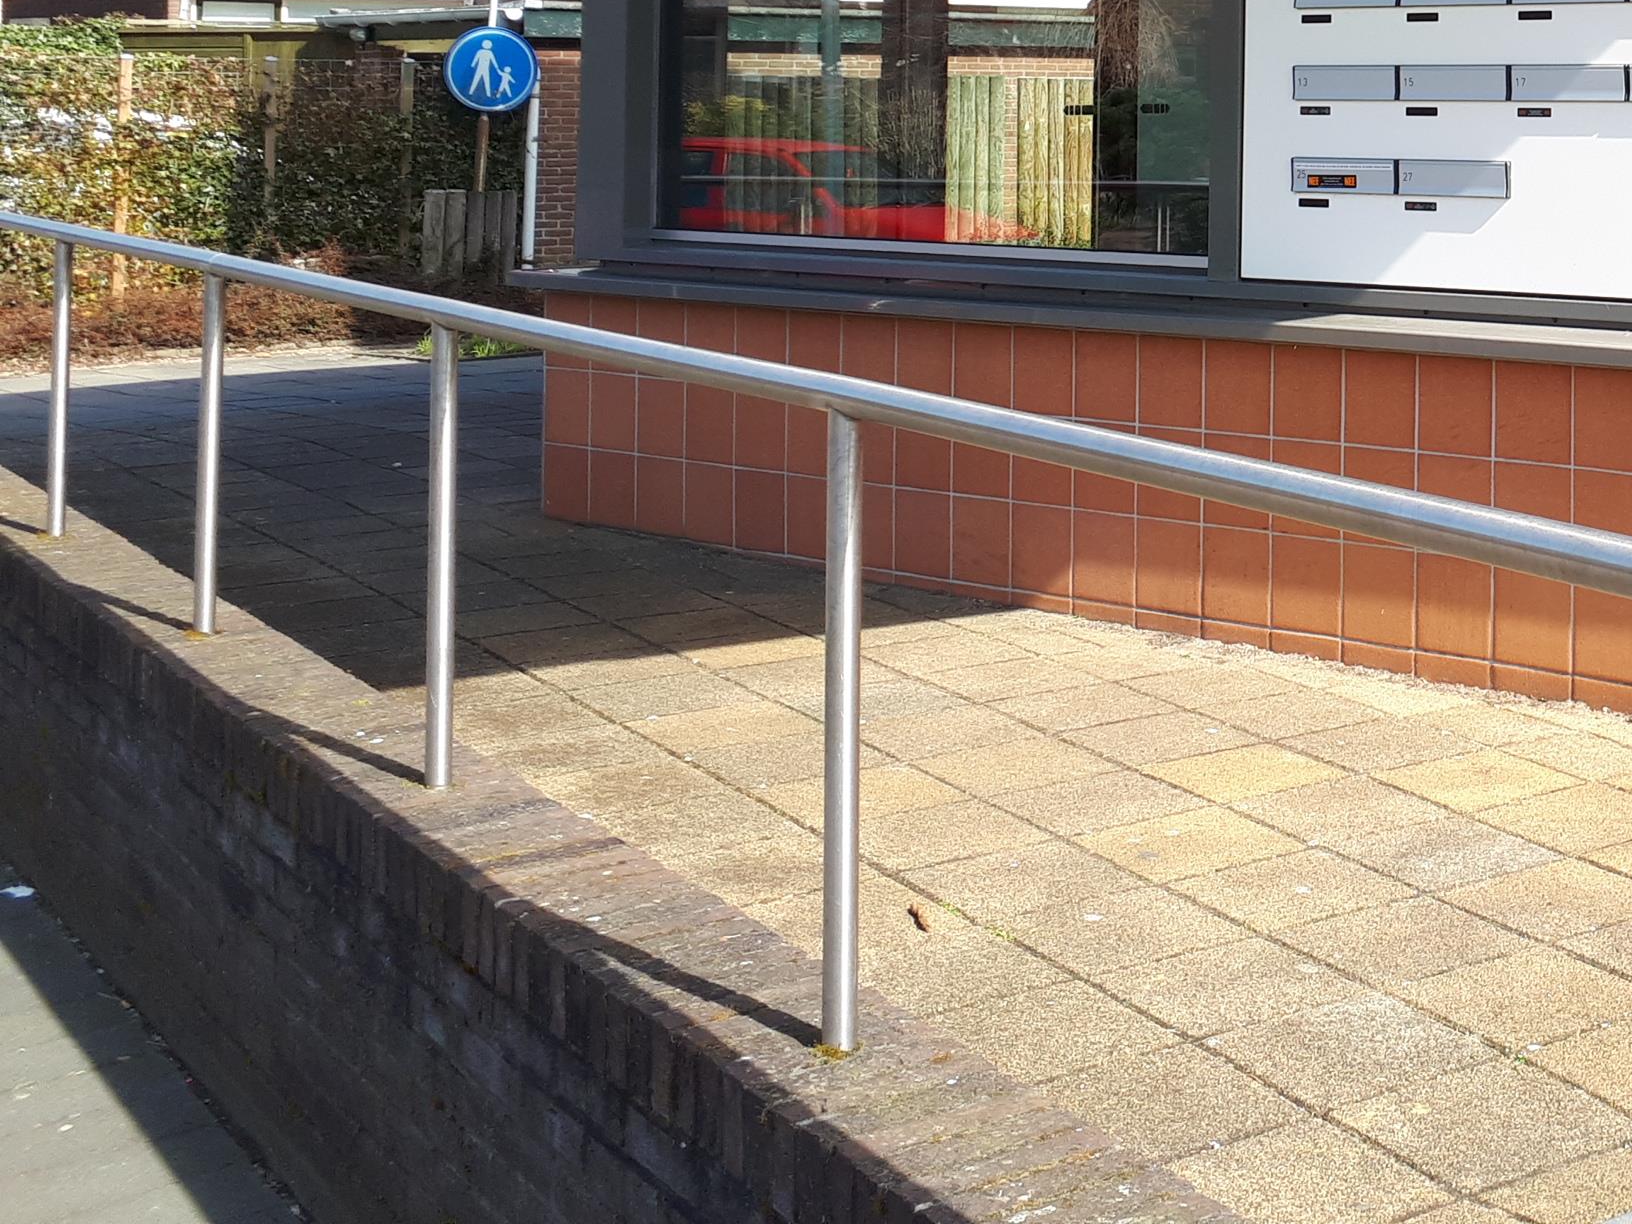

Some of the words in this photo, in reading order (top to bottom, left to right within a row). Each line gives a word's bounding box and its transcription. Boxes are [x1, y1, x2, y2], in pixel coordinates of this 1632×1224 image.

[1297, 77, 1308, 88] 13
[1403, 77, 1414, 87] 15
[1515, 77, 1526, 88] 17
[1296, 169, 1306, 180] 25
[1402, 171, 1413, 182] 27
